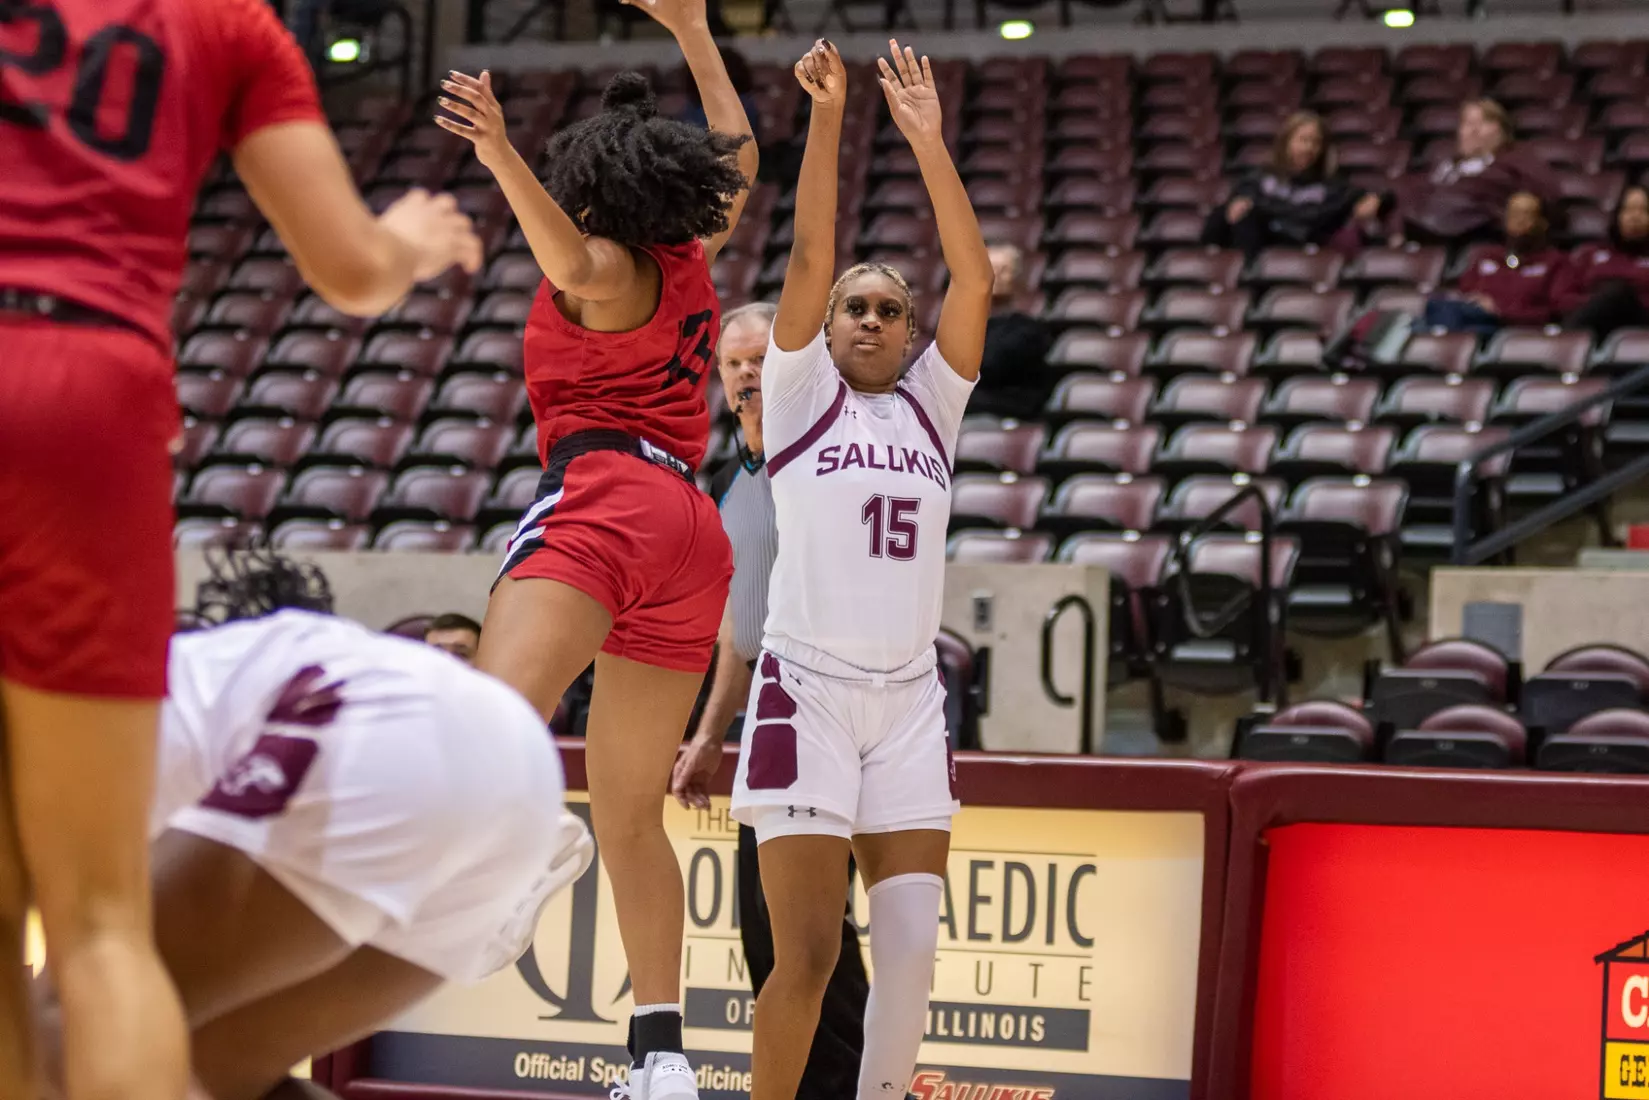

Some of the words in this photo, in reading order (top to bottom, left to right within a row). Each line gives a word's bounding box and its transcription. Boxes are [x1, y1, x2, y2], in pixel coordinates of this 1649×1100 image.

[816, 443, 947, 492] SALUKIS
[861, 493, 922, 562] 15
[514, 1051, 585, 1082] Official
[589, 1057, 630, 1088] Spo
[696, 1063, 753, 1093] dicine
[1619, 1054, 1649, 1088] GE
